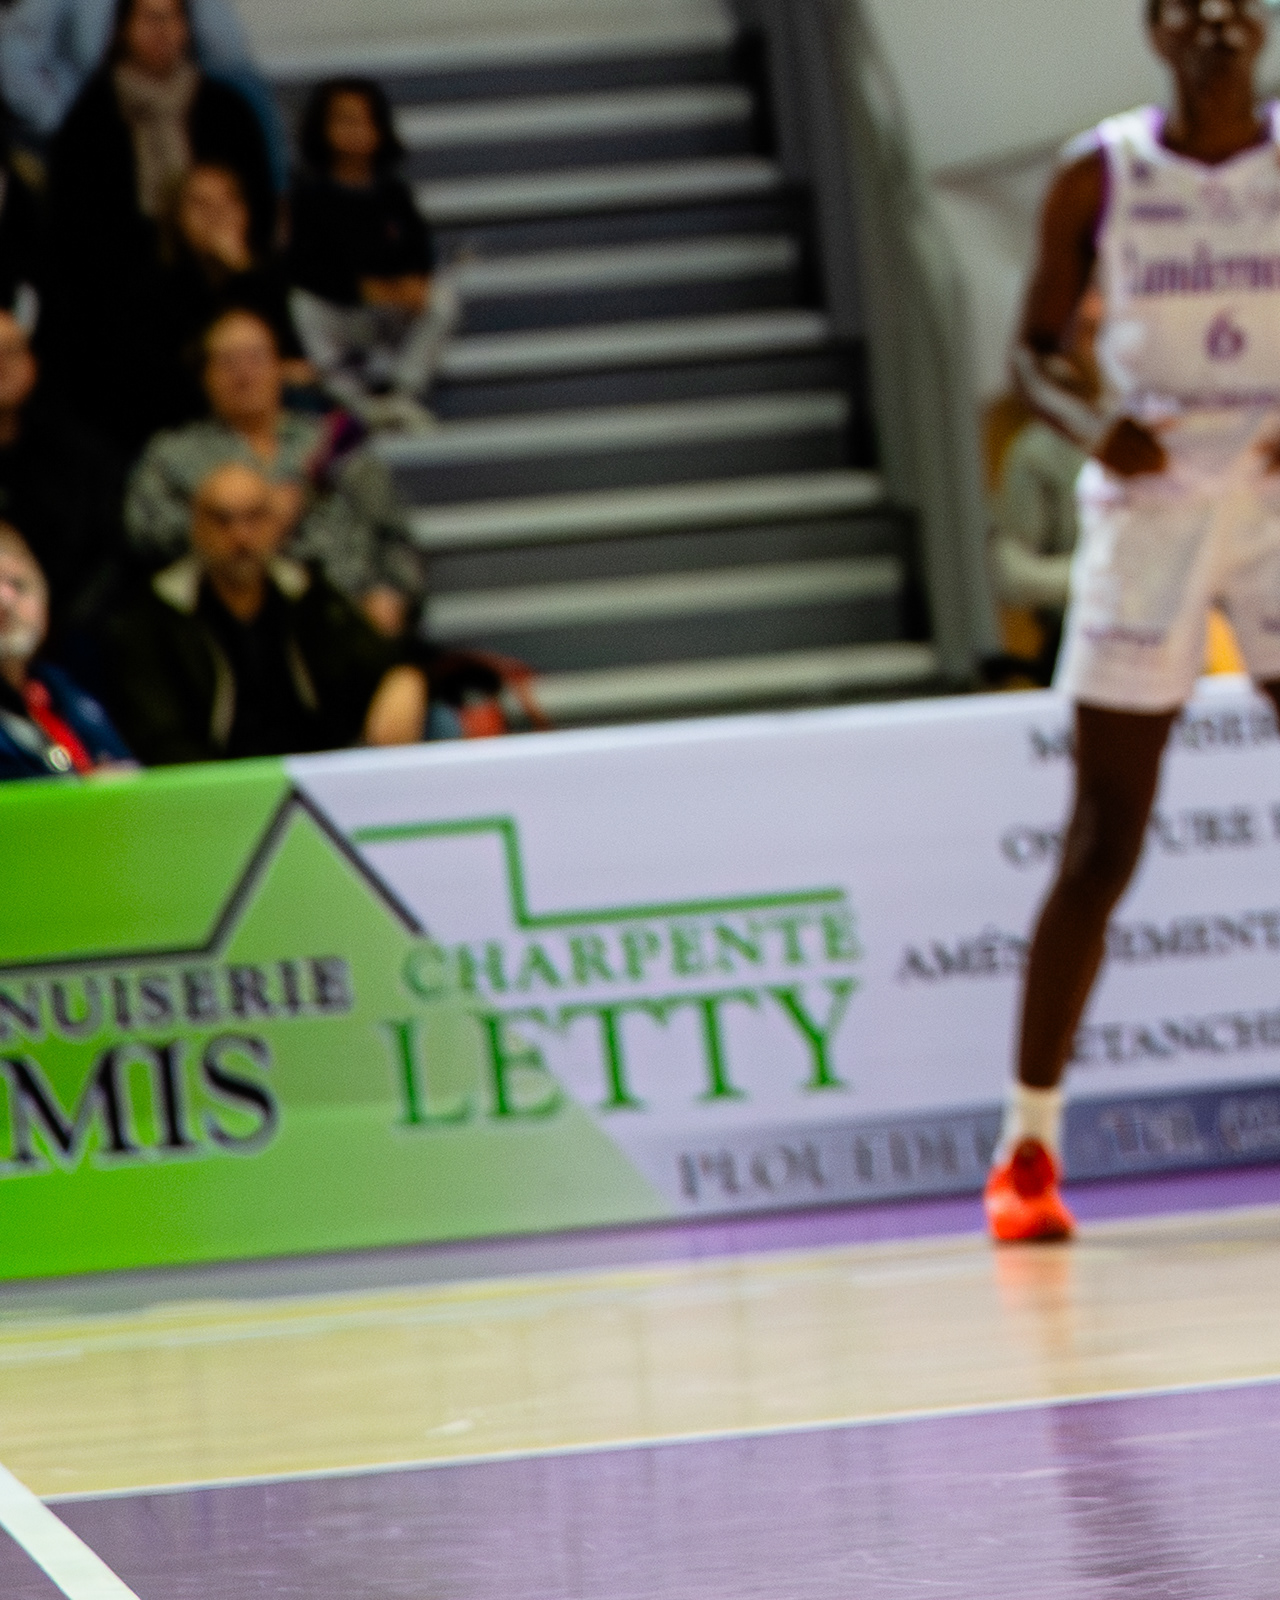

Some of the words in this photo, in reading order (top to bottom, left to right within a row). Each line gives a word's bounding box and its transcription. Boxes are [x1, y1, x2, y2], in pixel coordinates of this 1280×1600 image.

[1206, 308, 1246, 365] 6
[402, 903, 863, 1000] CHARPENTE
[386, 974, 861, 1127] LETTY
